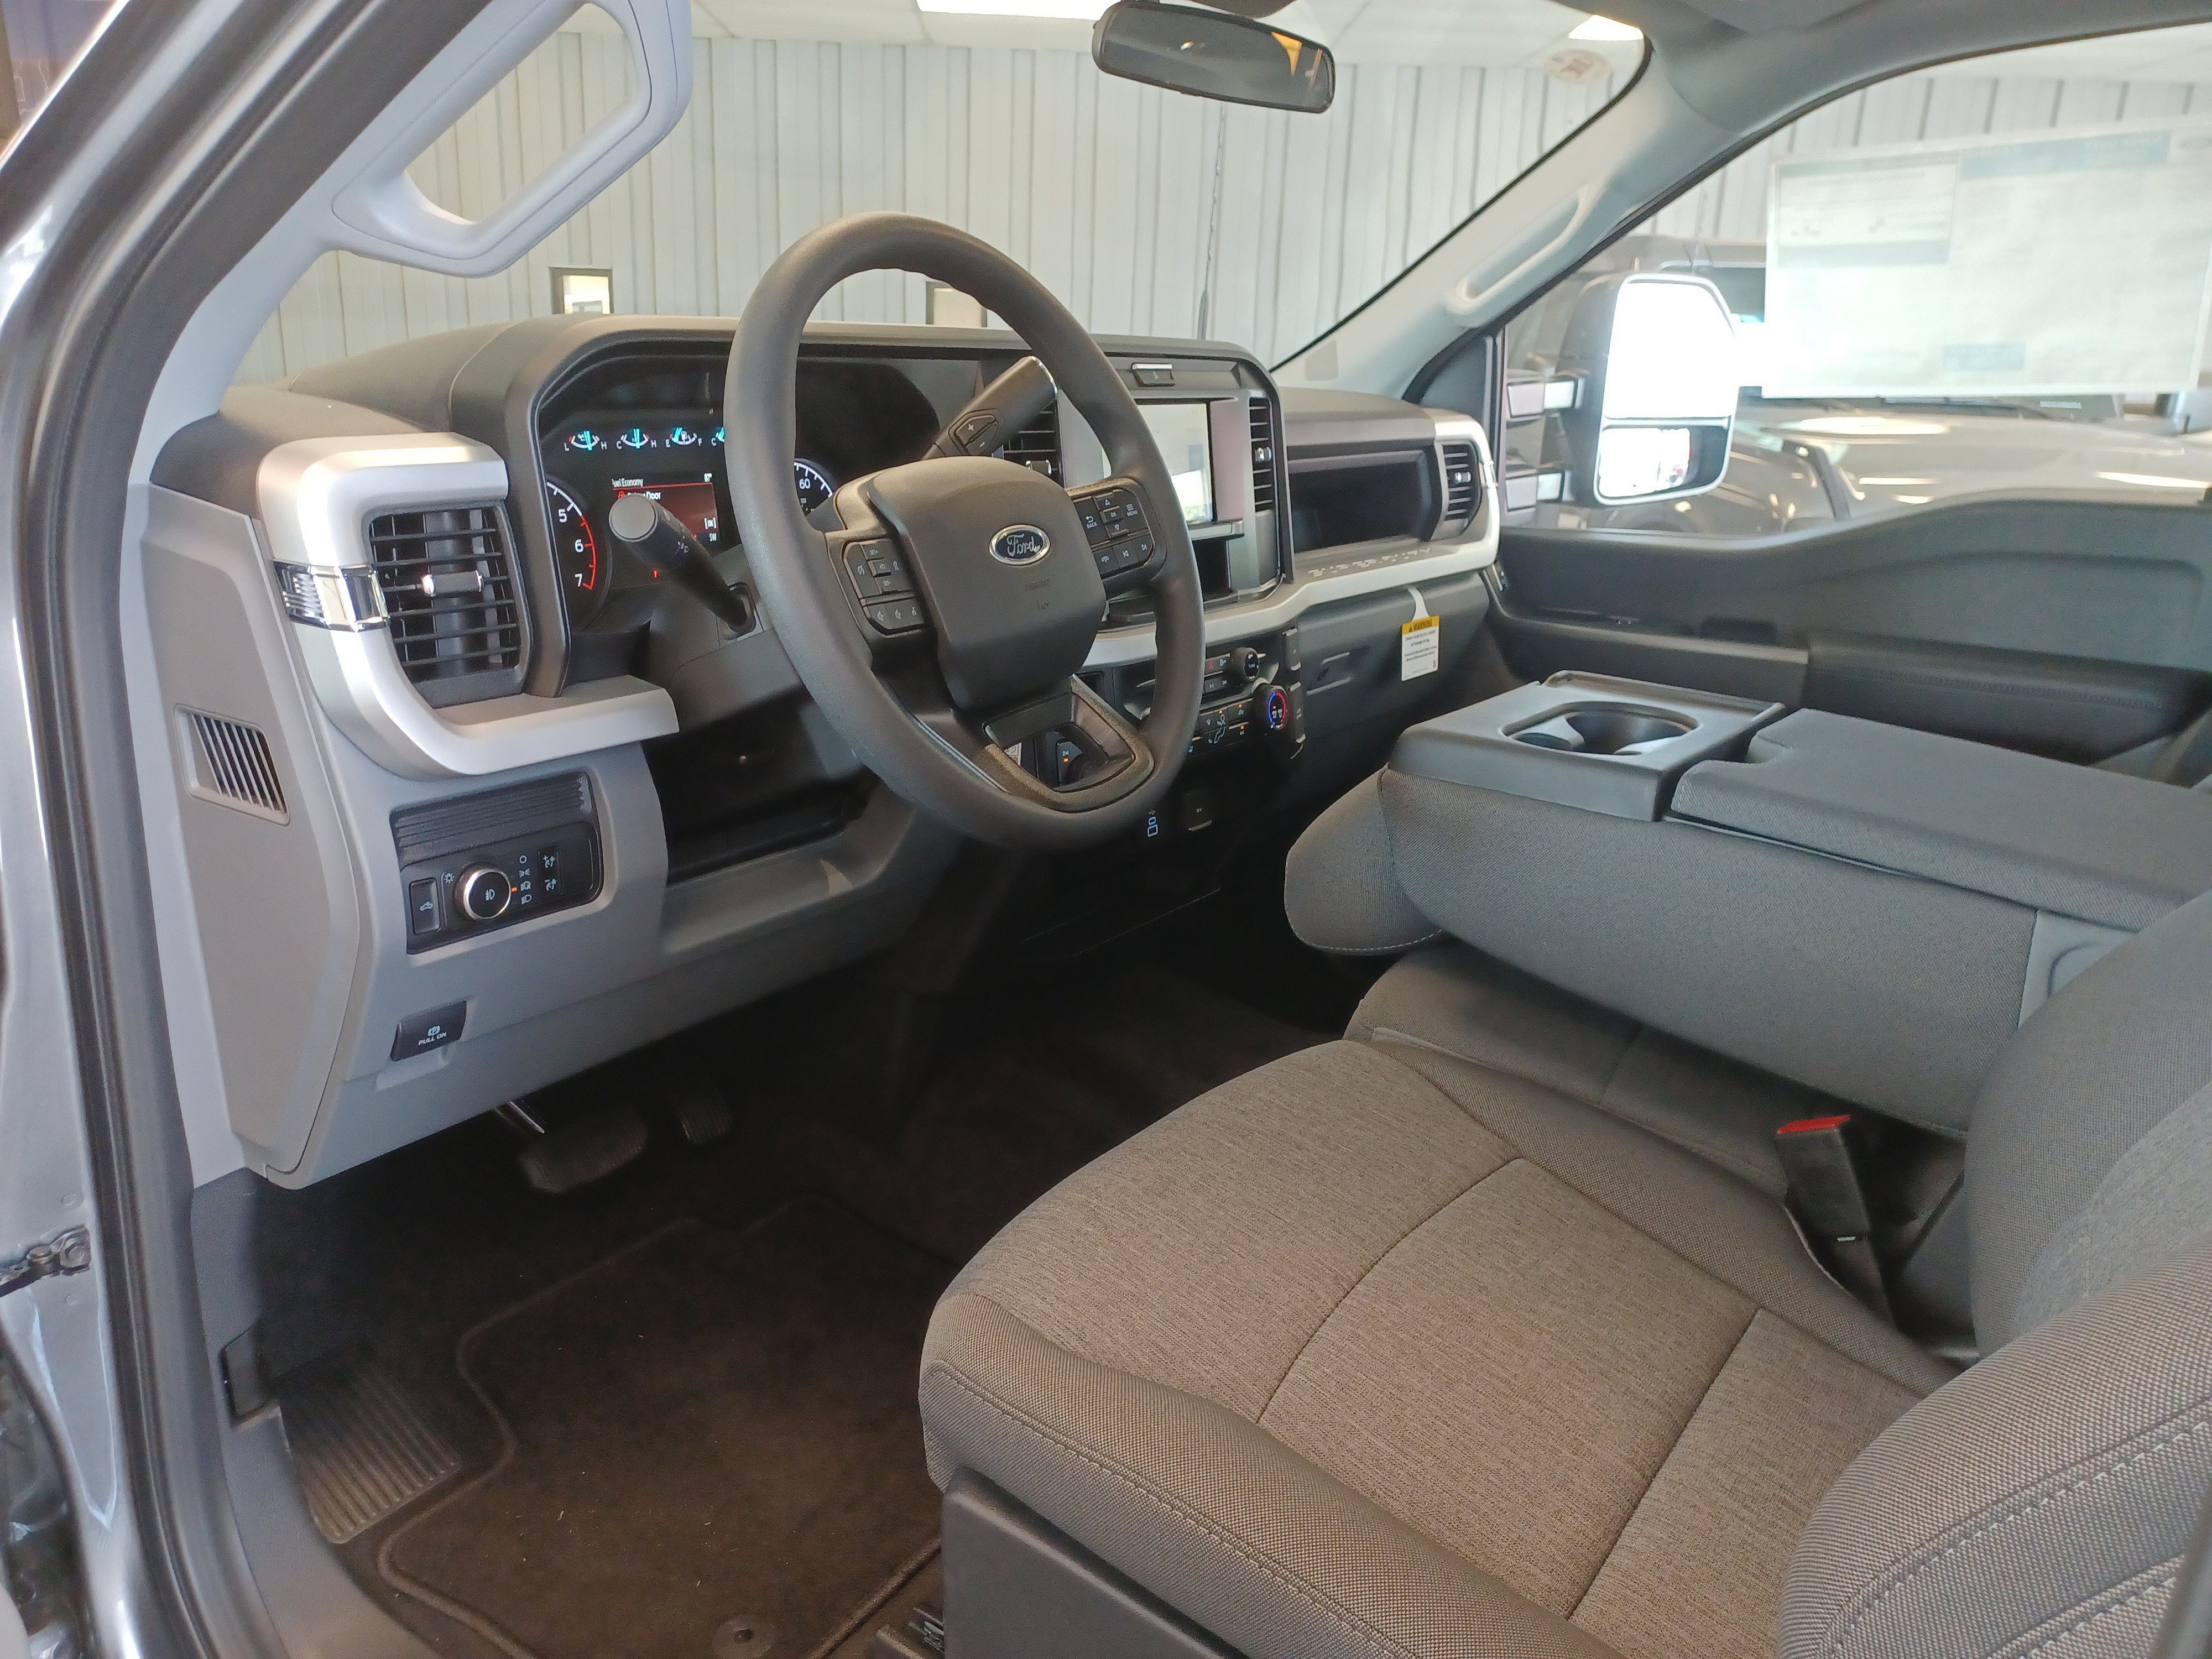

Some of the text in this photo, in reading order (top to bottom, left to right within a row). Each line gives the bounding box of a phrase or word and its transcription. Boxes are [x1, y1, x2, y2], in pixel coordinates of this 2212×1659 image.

[601, 441, 607, 450] H
[616, 441, 622, 449] C
[651, 440, 657, 448] H
[665, 439, 671, 448] E
[698, 438, 702, 446] F
[622, 478, 644, 487] Economy
[799, 478, 810, 489] 60
[646, 491, 661, 499] Door
[558, 509, 567, 523] 5
[709, 533, 717, 541] SW
[575, 539, 584, 552] 6
[1006, 533, 1041, 557] Ford
[575, 573, 582, 587] 7
[418, 1036, 435, 1045] PULL
